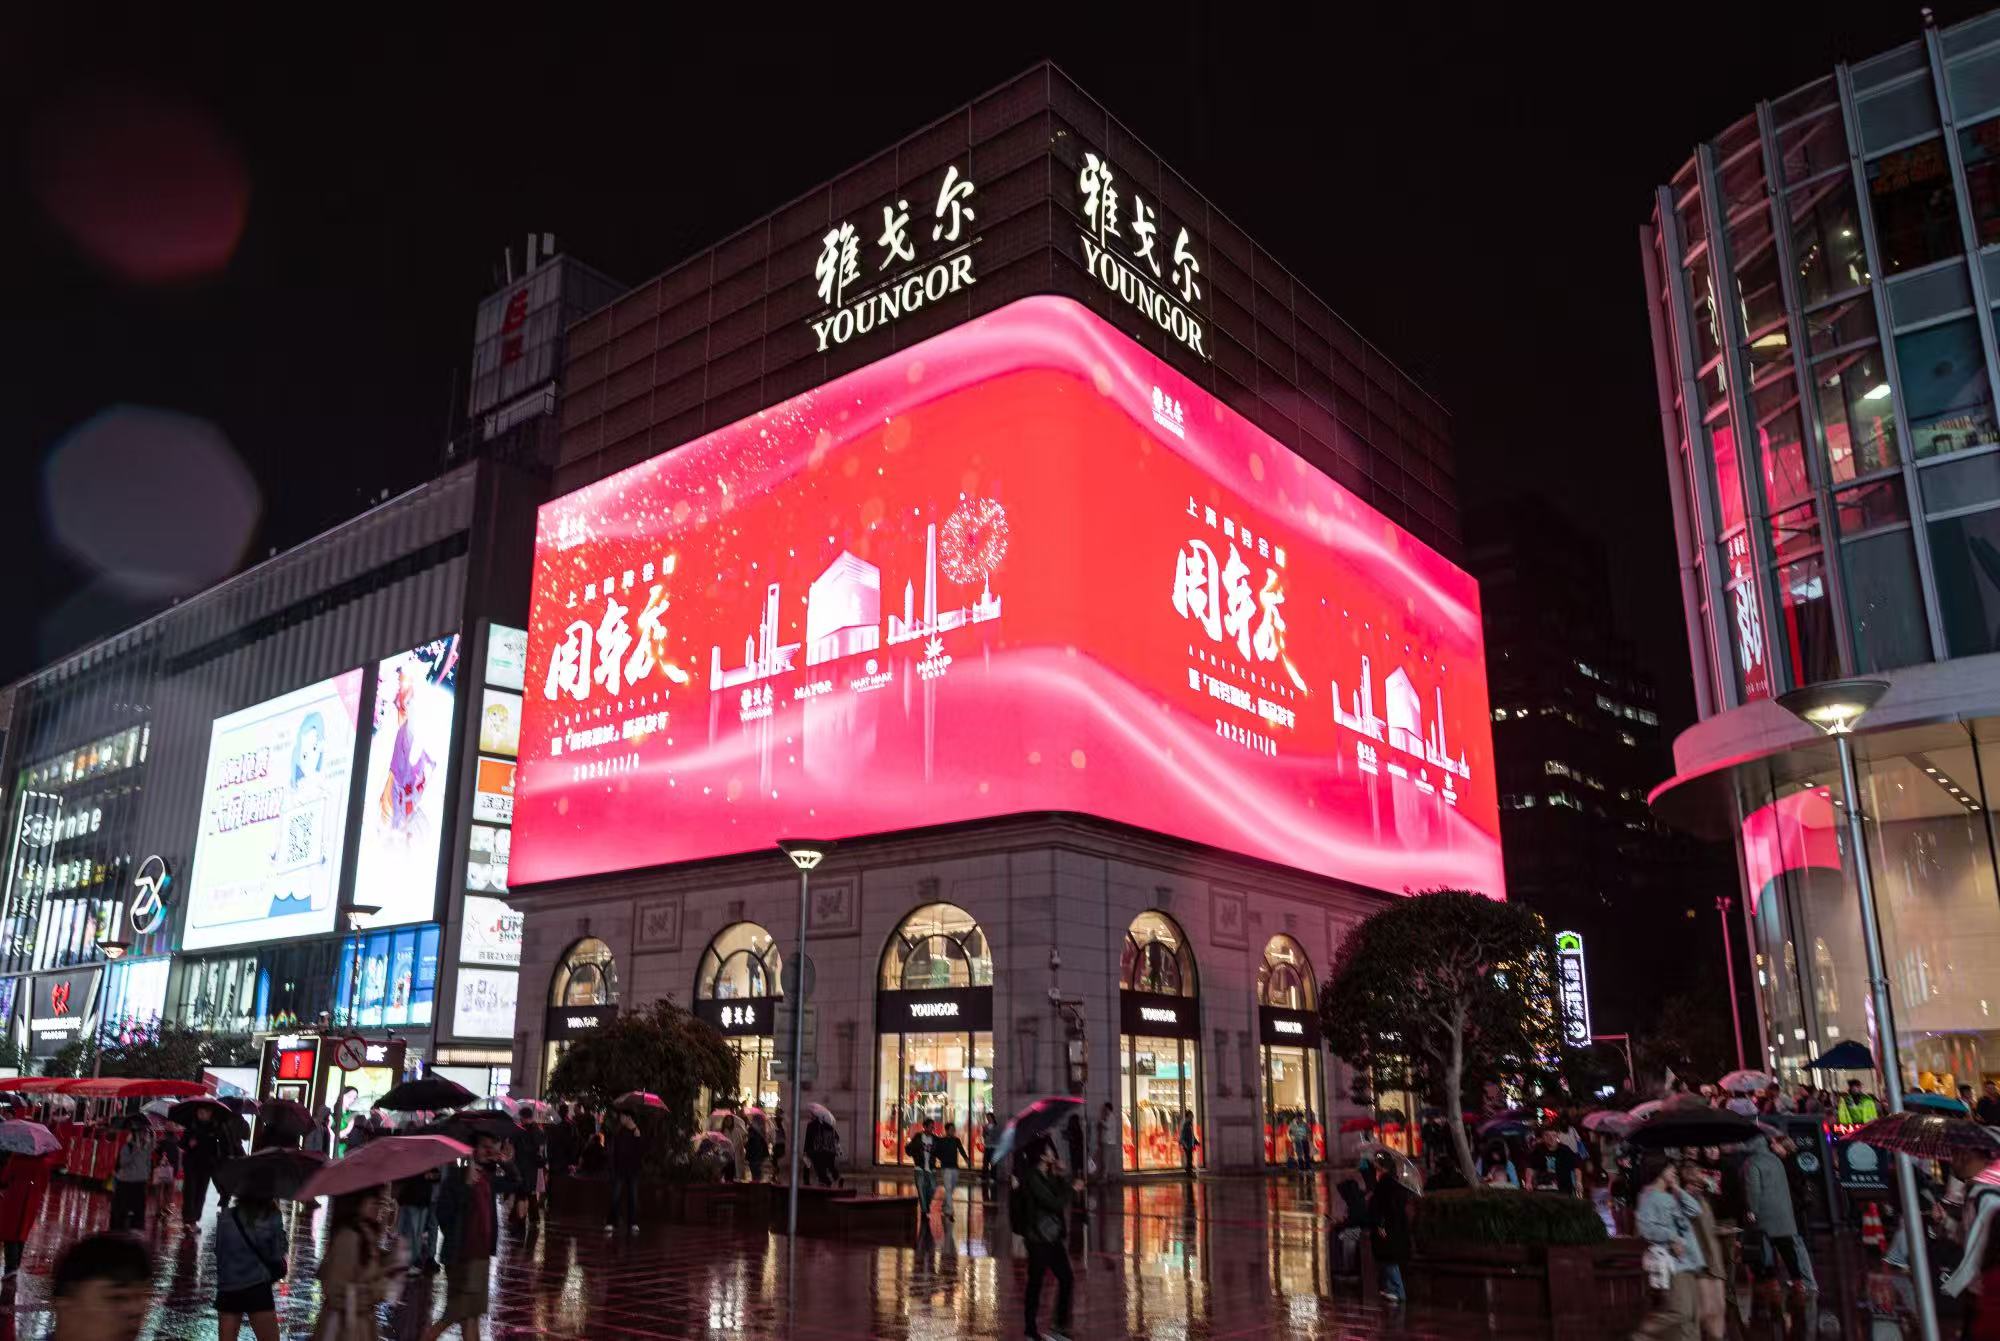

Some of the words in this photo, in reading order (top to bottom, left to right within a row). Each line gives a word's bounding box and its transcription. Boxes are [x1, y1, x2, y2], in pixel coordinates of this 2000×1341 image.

[815, 165, 975, 308] 雅戈尔
[1080, 153, 1200, 303] 雅戈尔
[812, 254, 977, 353] YOUNGOR
[1081, 235, 1205, 357] YOUNGOR
[793, 680, 833, 701] MAYOR
[910, 1002, 960, 1017] YOUNGOR
[1140, 1007, 1177, 1023] YOUNGOR
